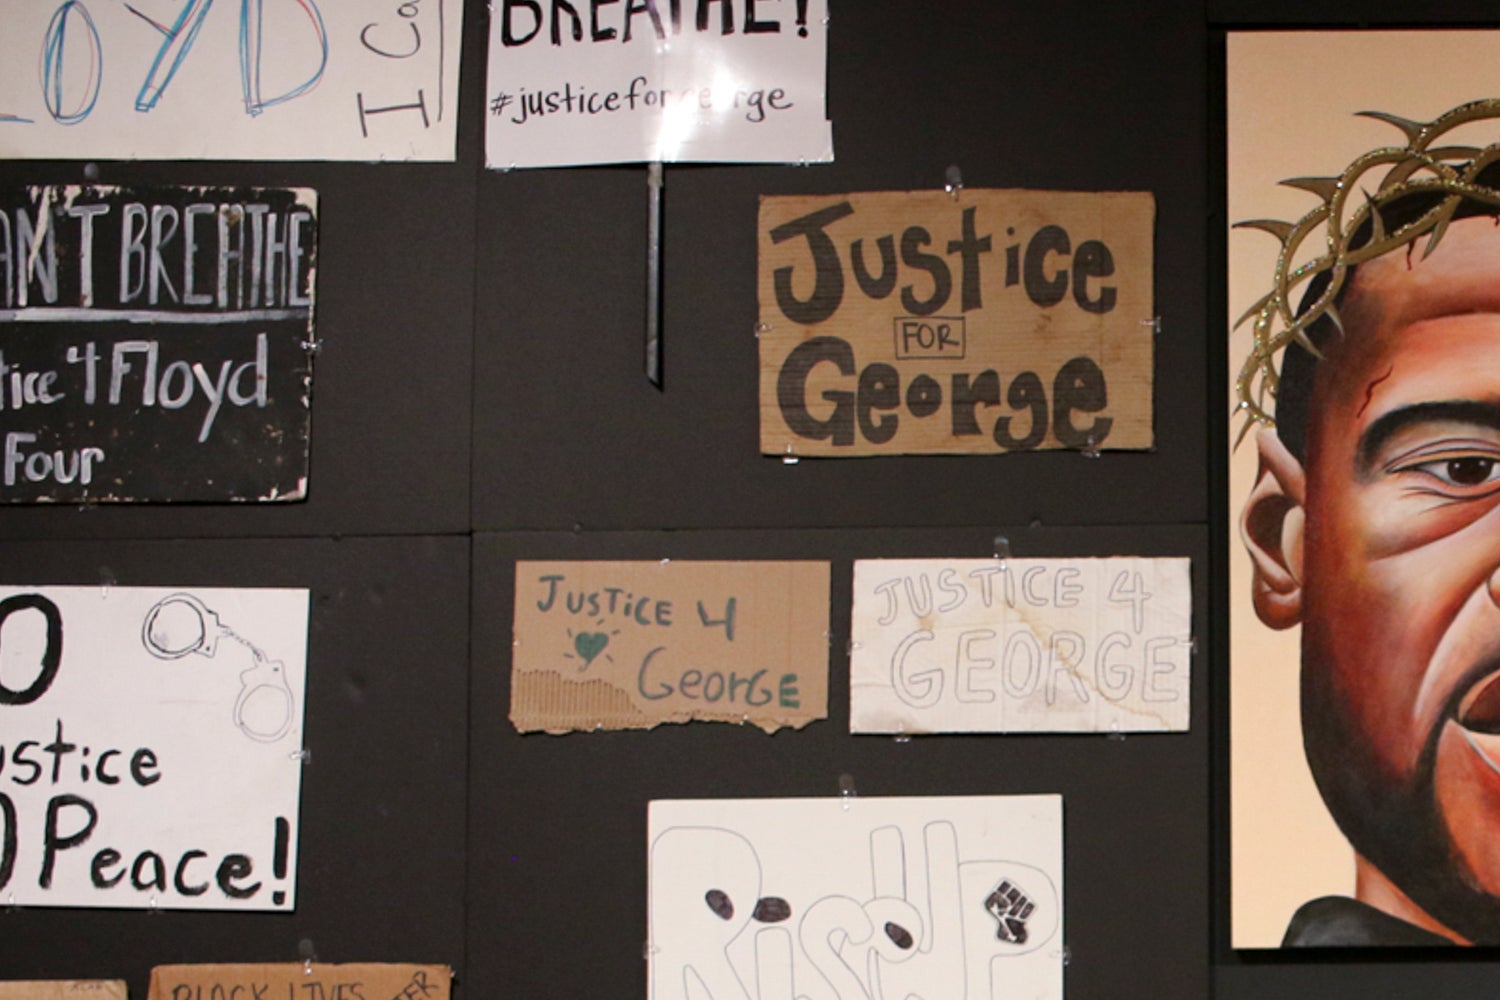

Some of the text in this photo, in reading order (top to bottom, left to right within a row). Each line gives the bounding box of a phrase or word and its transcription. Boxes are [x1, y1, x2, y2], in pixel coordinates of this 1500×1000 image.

[490, 76, 794, 124] #justiceforerge
[120, 202, 313, 309] BREATHE
[769, 201, 1118, 325] Justice
[902, 320, 960, 352] FOR
[66, 341, 102, 405] 4
[109, 333, 268, 442] Floyd
[777, 335, 1113, 450] George
[4, 432, 105, 486] Four
[697, 597, 737, 641] 4
[874, 565, 1151, 634] JUSTICE 4
[891, 628, 1181, 710] GEORGE
[0, 718, 161, 786] stice
[39, 794, 290, 905] Peace!
